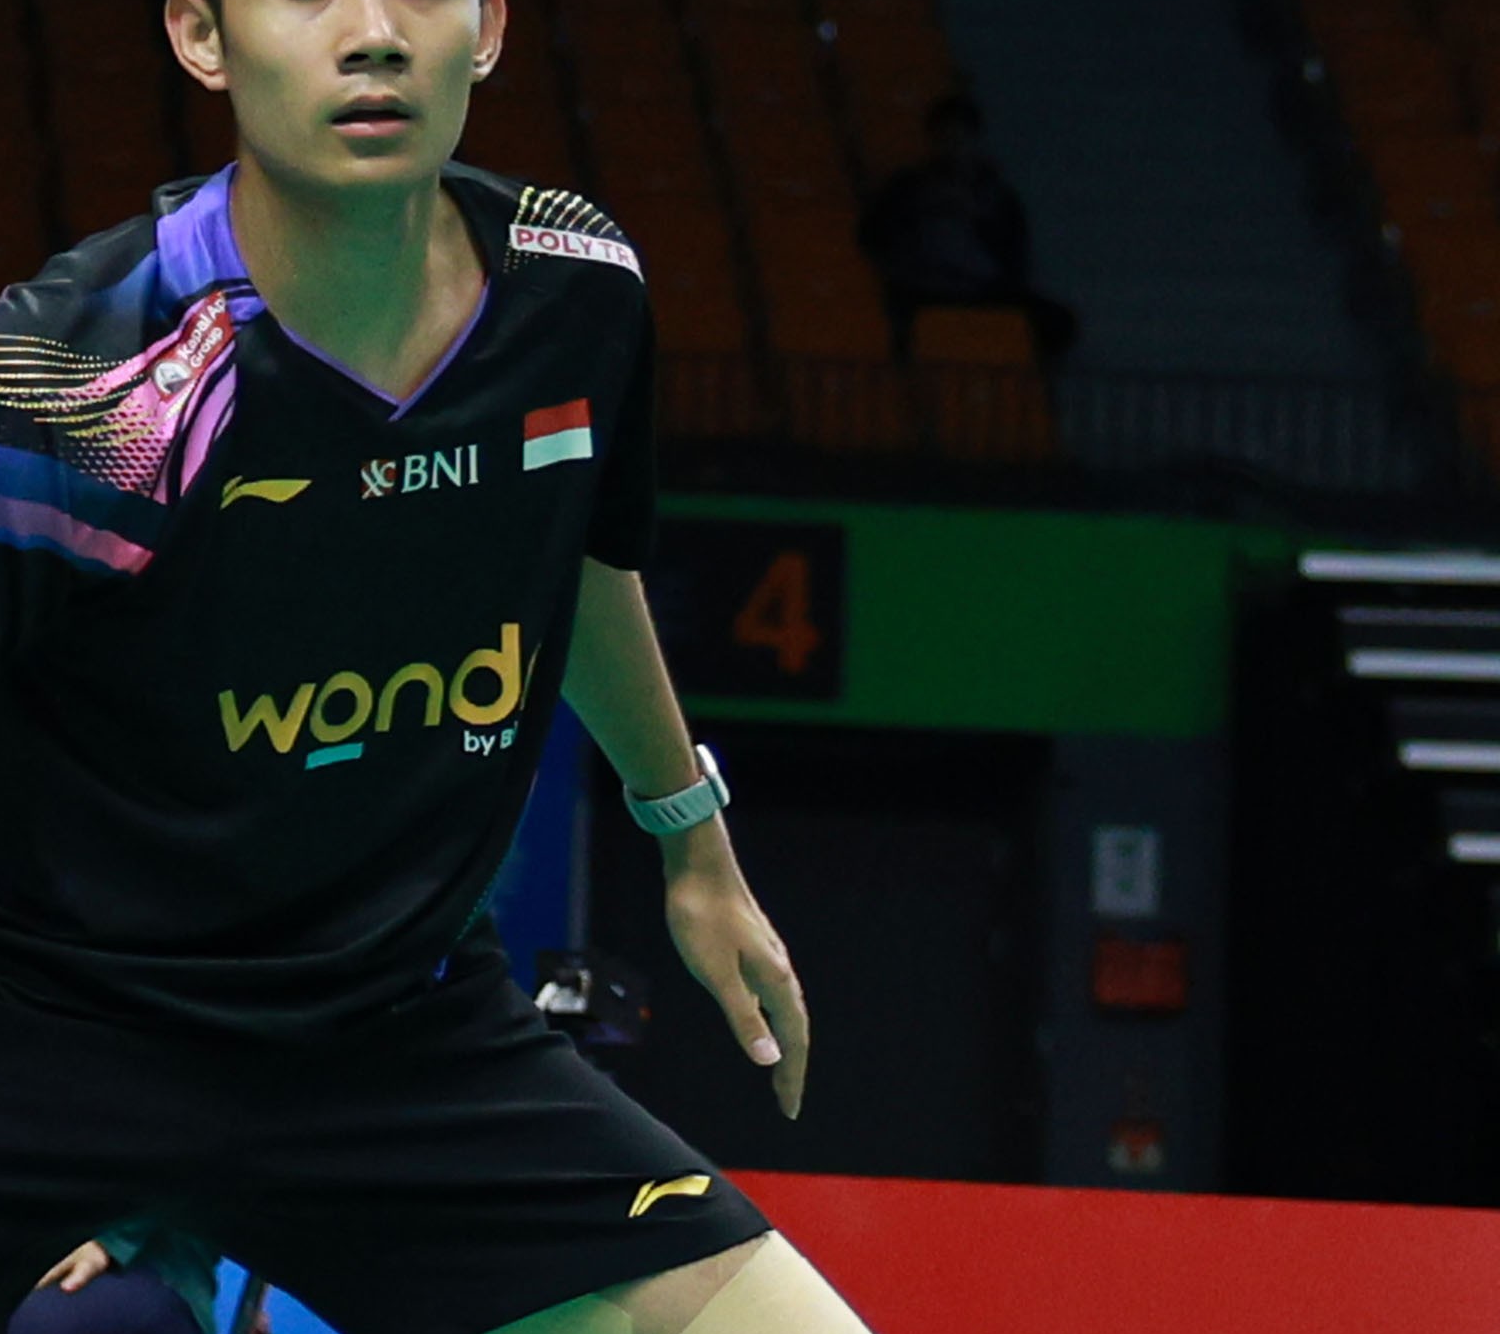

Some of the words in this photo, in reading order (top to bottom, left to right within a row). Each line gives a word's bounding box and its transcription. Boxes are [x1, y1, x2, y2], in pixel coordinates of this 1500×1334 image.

[177, 313, 213, 361] Kapal
[206, 295, 227, 320] Ap
[190, 326, 224, 368] Group
[400, 443, 480, 494] BNI
[731, 550, 827, 677] 4
[217, 622, 541, 754] wond
[462, 729, 497, 757] by
